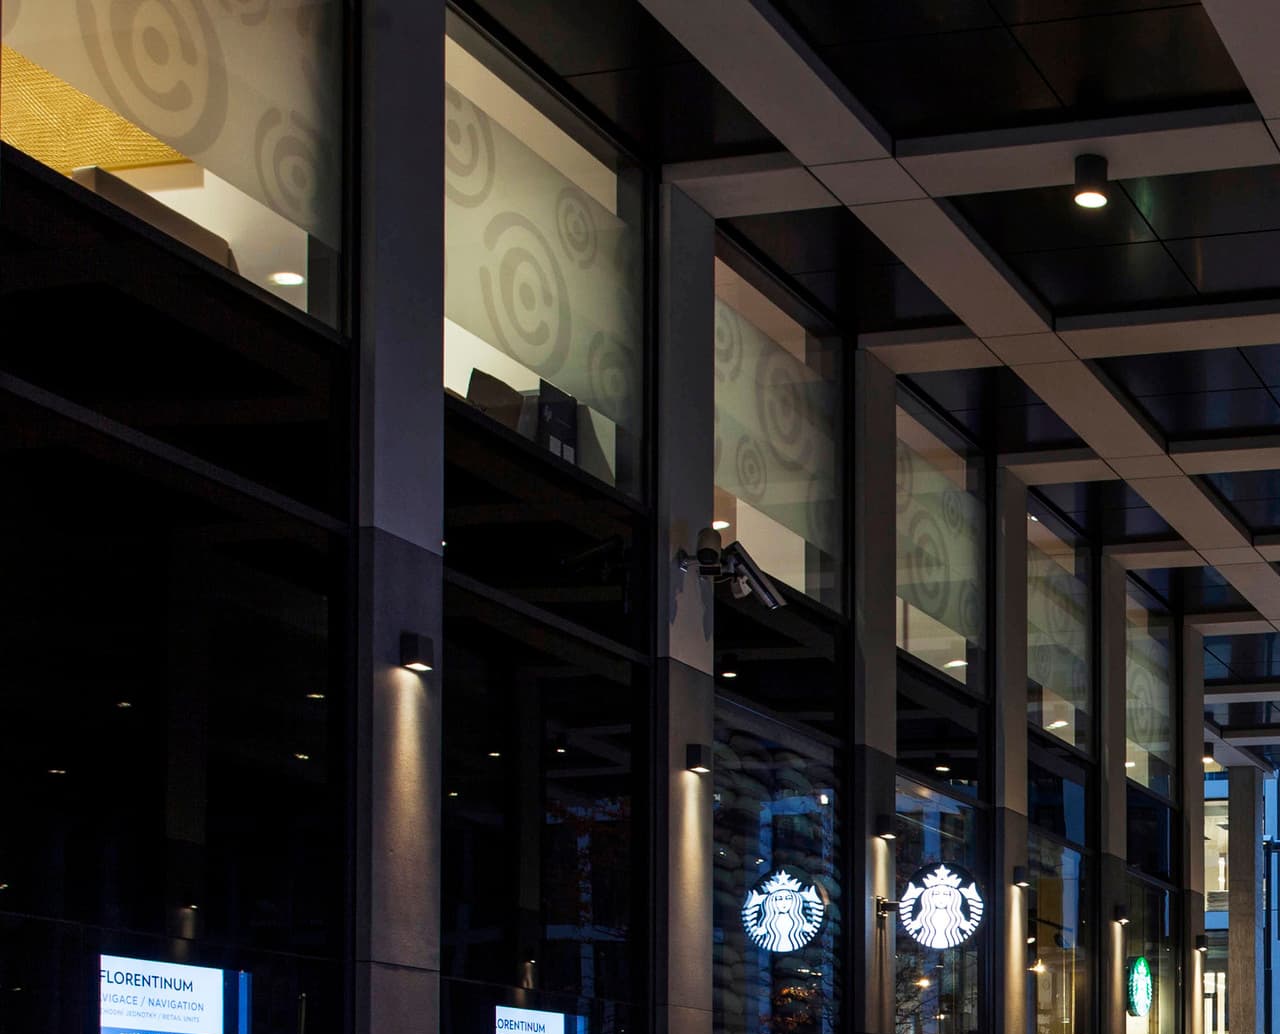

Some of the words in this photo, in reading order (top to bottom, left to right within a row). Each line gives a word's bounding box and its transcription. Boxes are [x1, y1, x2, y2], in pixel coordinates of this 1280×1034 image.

[100, 970, 193, 992] FLORENTINUM
[101, 993, 138, 1006] VIGACE
[148, 997, 204, 1012] NAVIGATION
